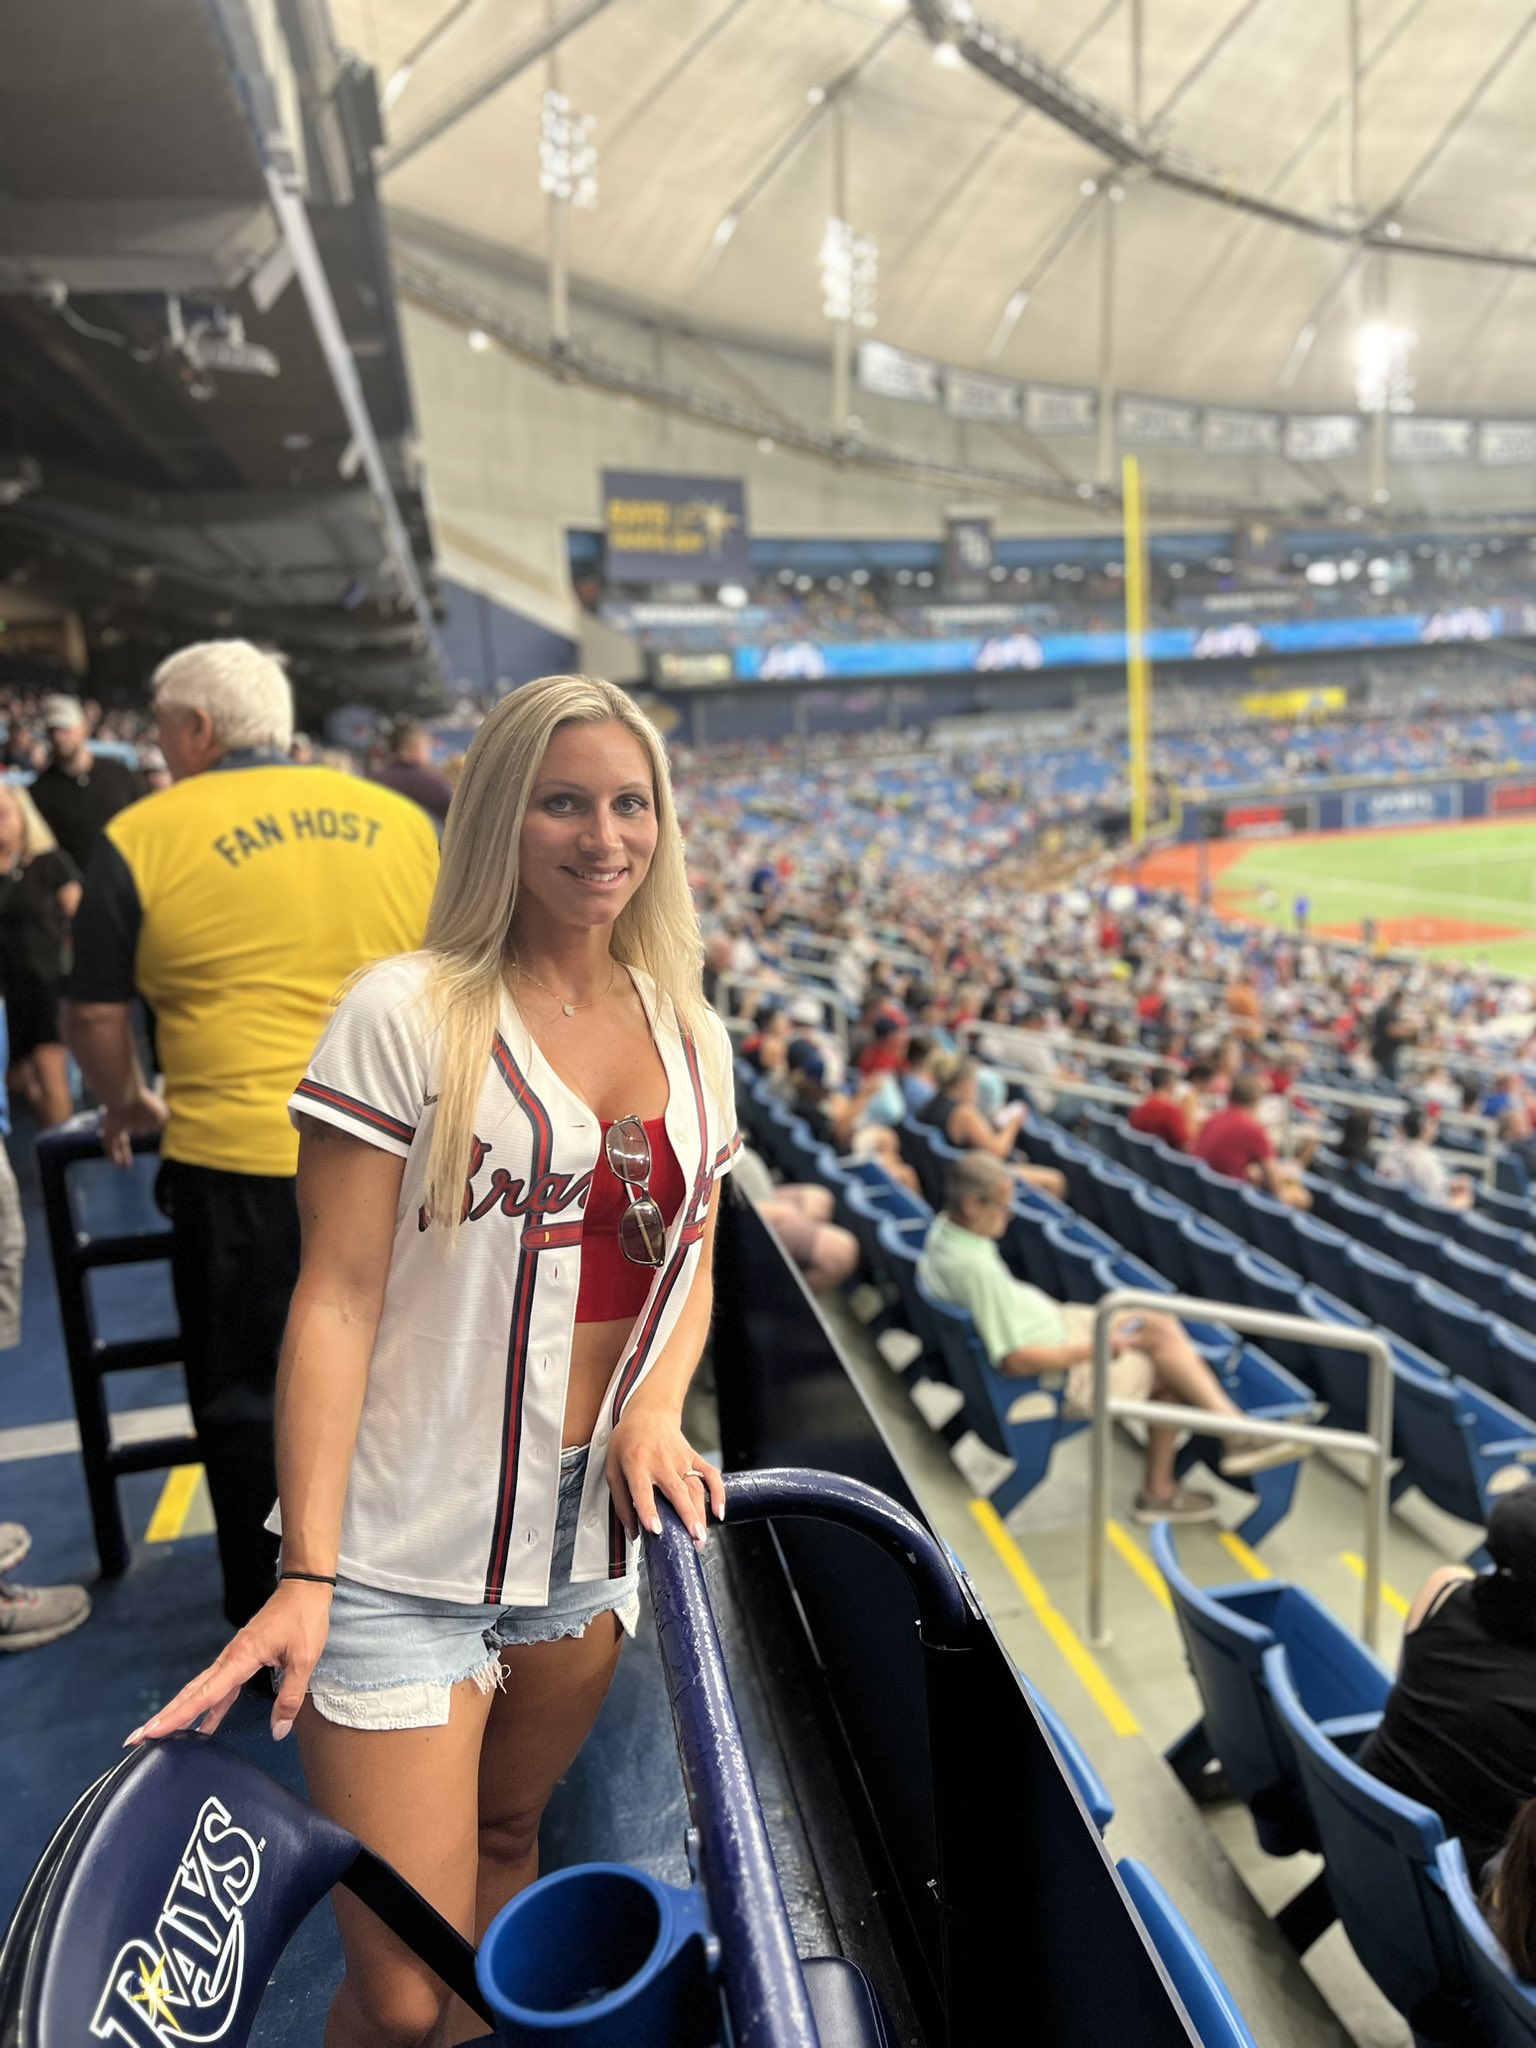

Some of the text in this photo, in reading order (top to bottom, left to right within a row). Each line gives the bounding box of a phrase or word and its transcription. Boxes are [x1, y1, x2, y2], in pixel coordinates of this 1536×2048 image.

[213, 808, 381, 868] FAN HOST
[90, 1796, 260, 2048] RAYS
